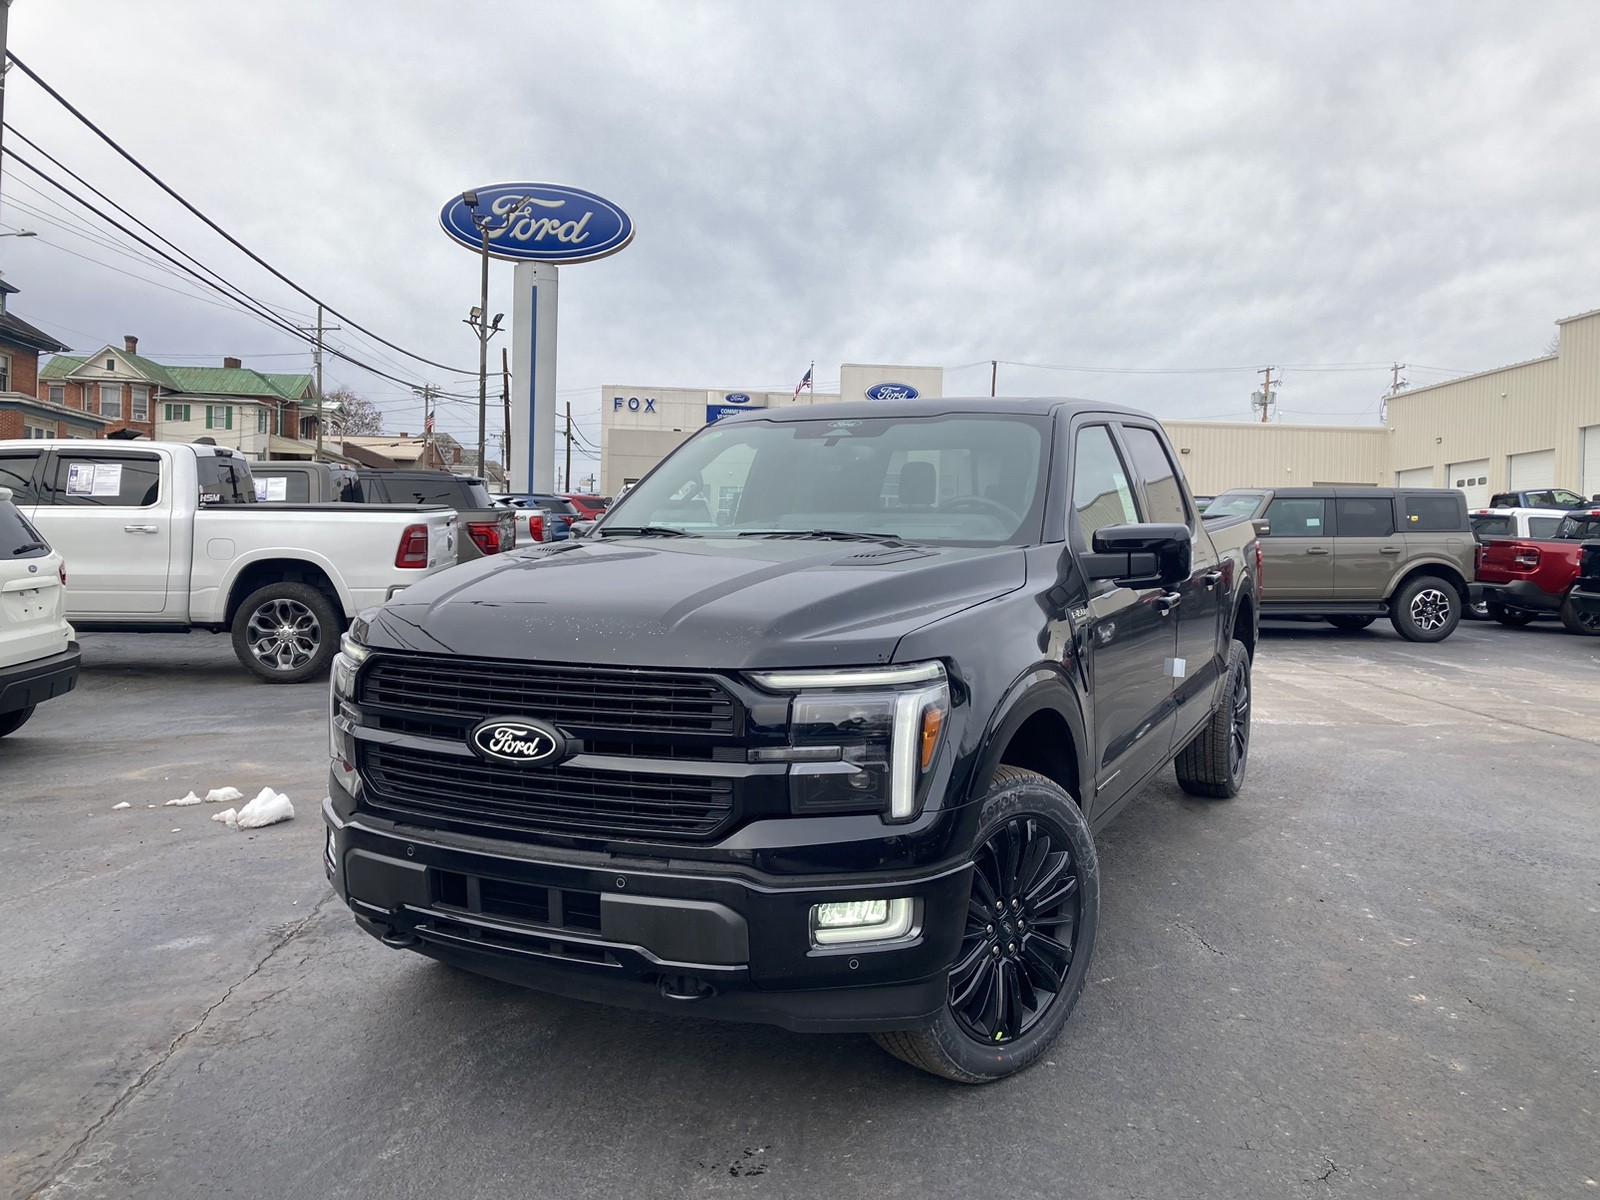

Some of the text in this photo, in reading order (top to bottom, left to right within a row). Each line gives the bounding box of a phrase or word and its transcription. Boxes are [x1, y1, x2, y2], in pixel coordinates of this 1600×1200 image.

[476, 195, 593, 244] Ford
[877, 386, 909, 400] Ford
[613, 397, 657, 413] FOX
[489, 727, 540, 756] Ford
